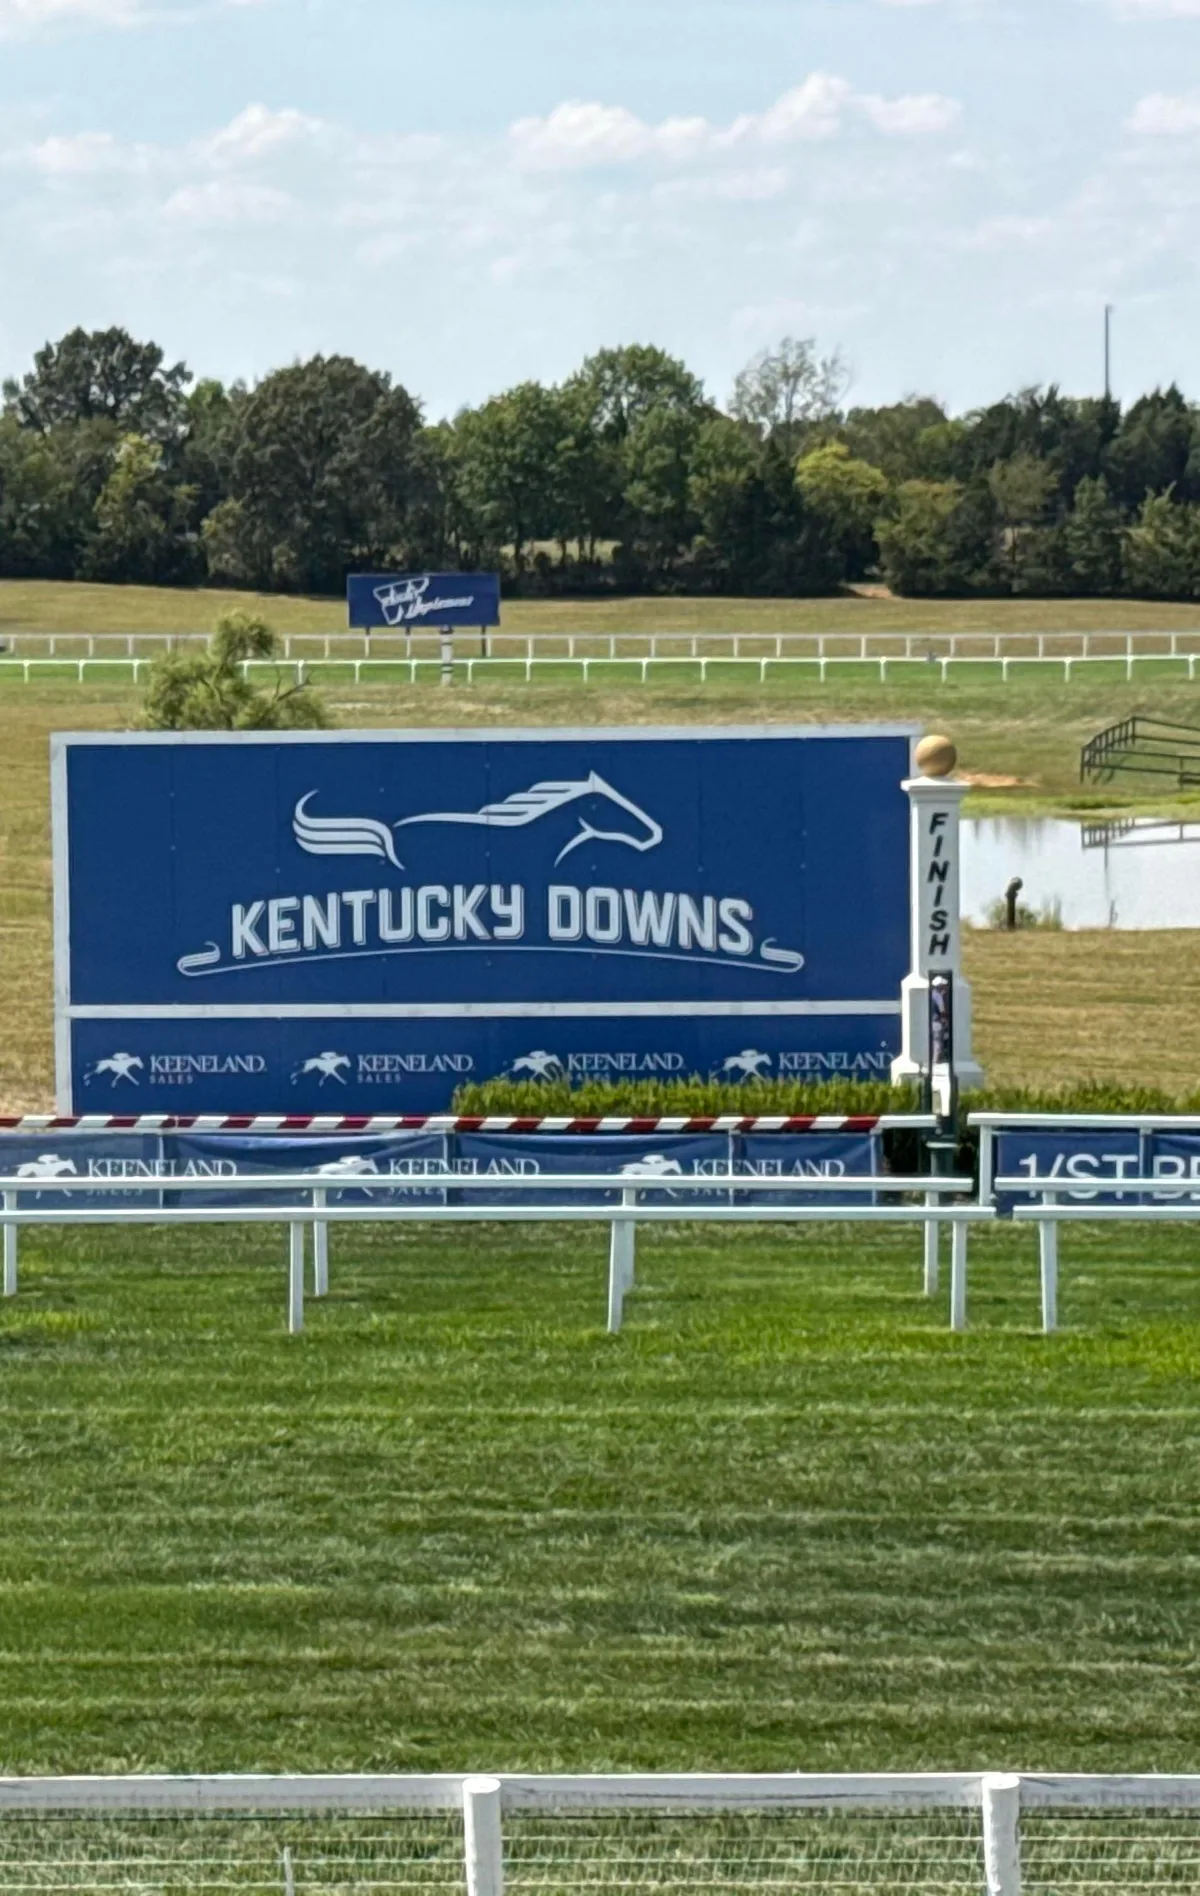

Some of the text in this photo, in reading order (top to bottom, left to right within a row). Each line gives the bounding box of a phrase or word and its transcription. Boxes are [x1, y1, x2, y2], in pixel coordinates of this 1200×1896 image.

[927, 812, 950, 956] FINISH
[232, 884, 754, 959] KENTUCKY DOWNS
[150, 1054, 266, 1073] KEENELAND
[357, 1054, 474, 1072] KEENELAND
[567, 1052, 685, 1071] KEENELAND
